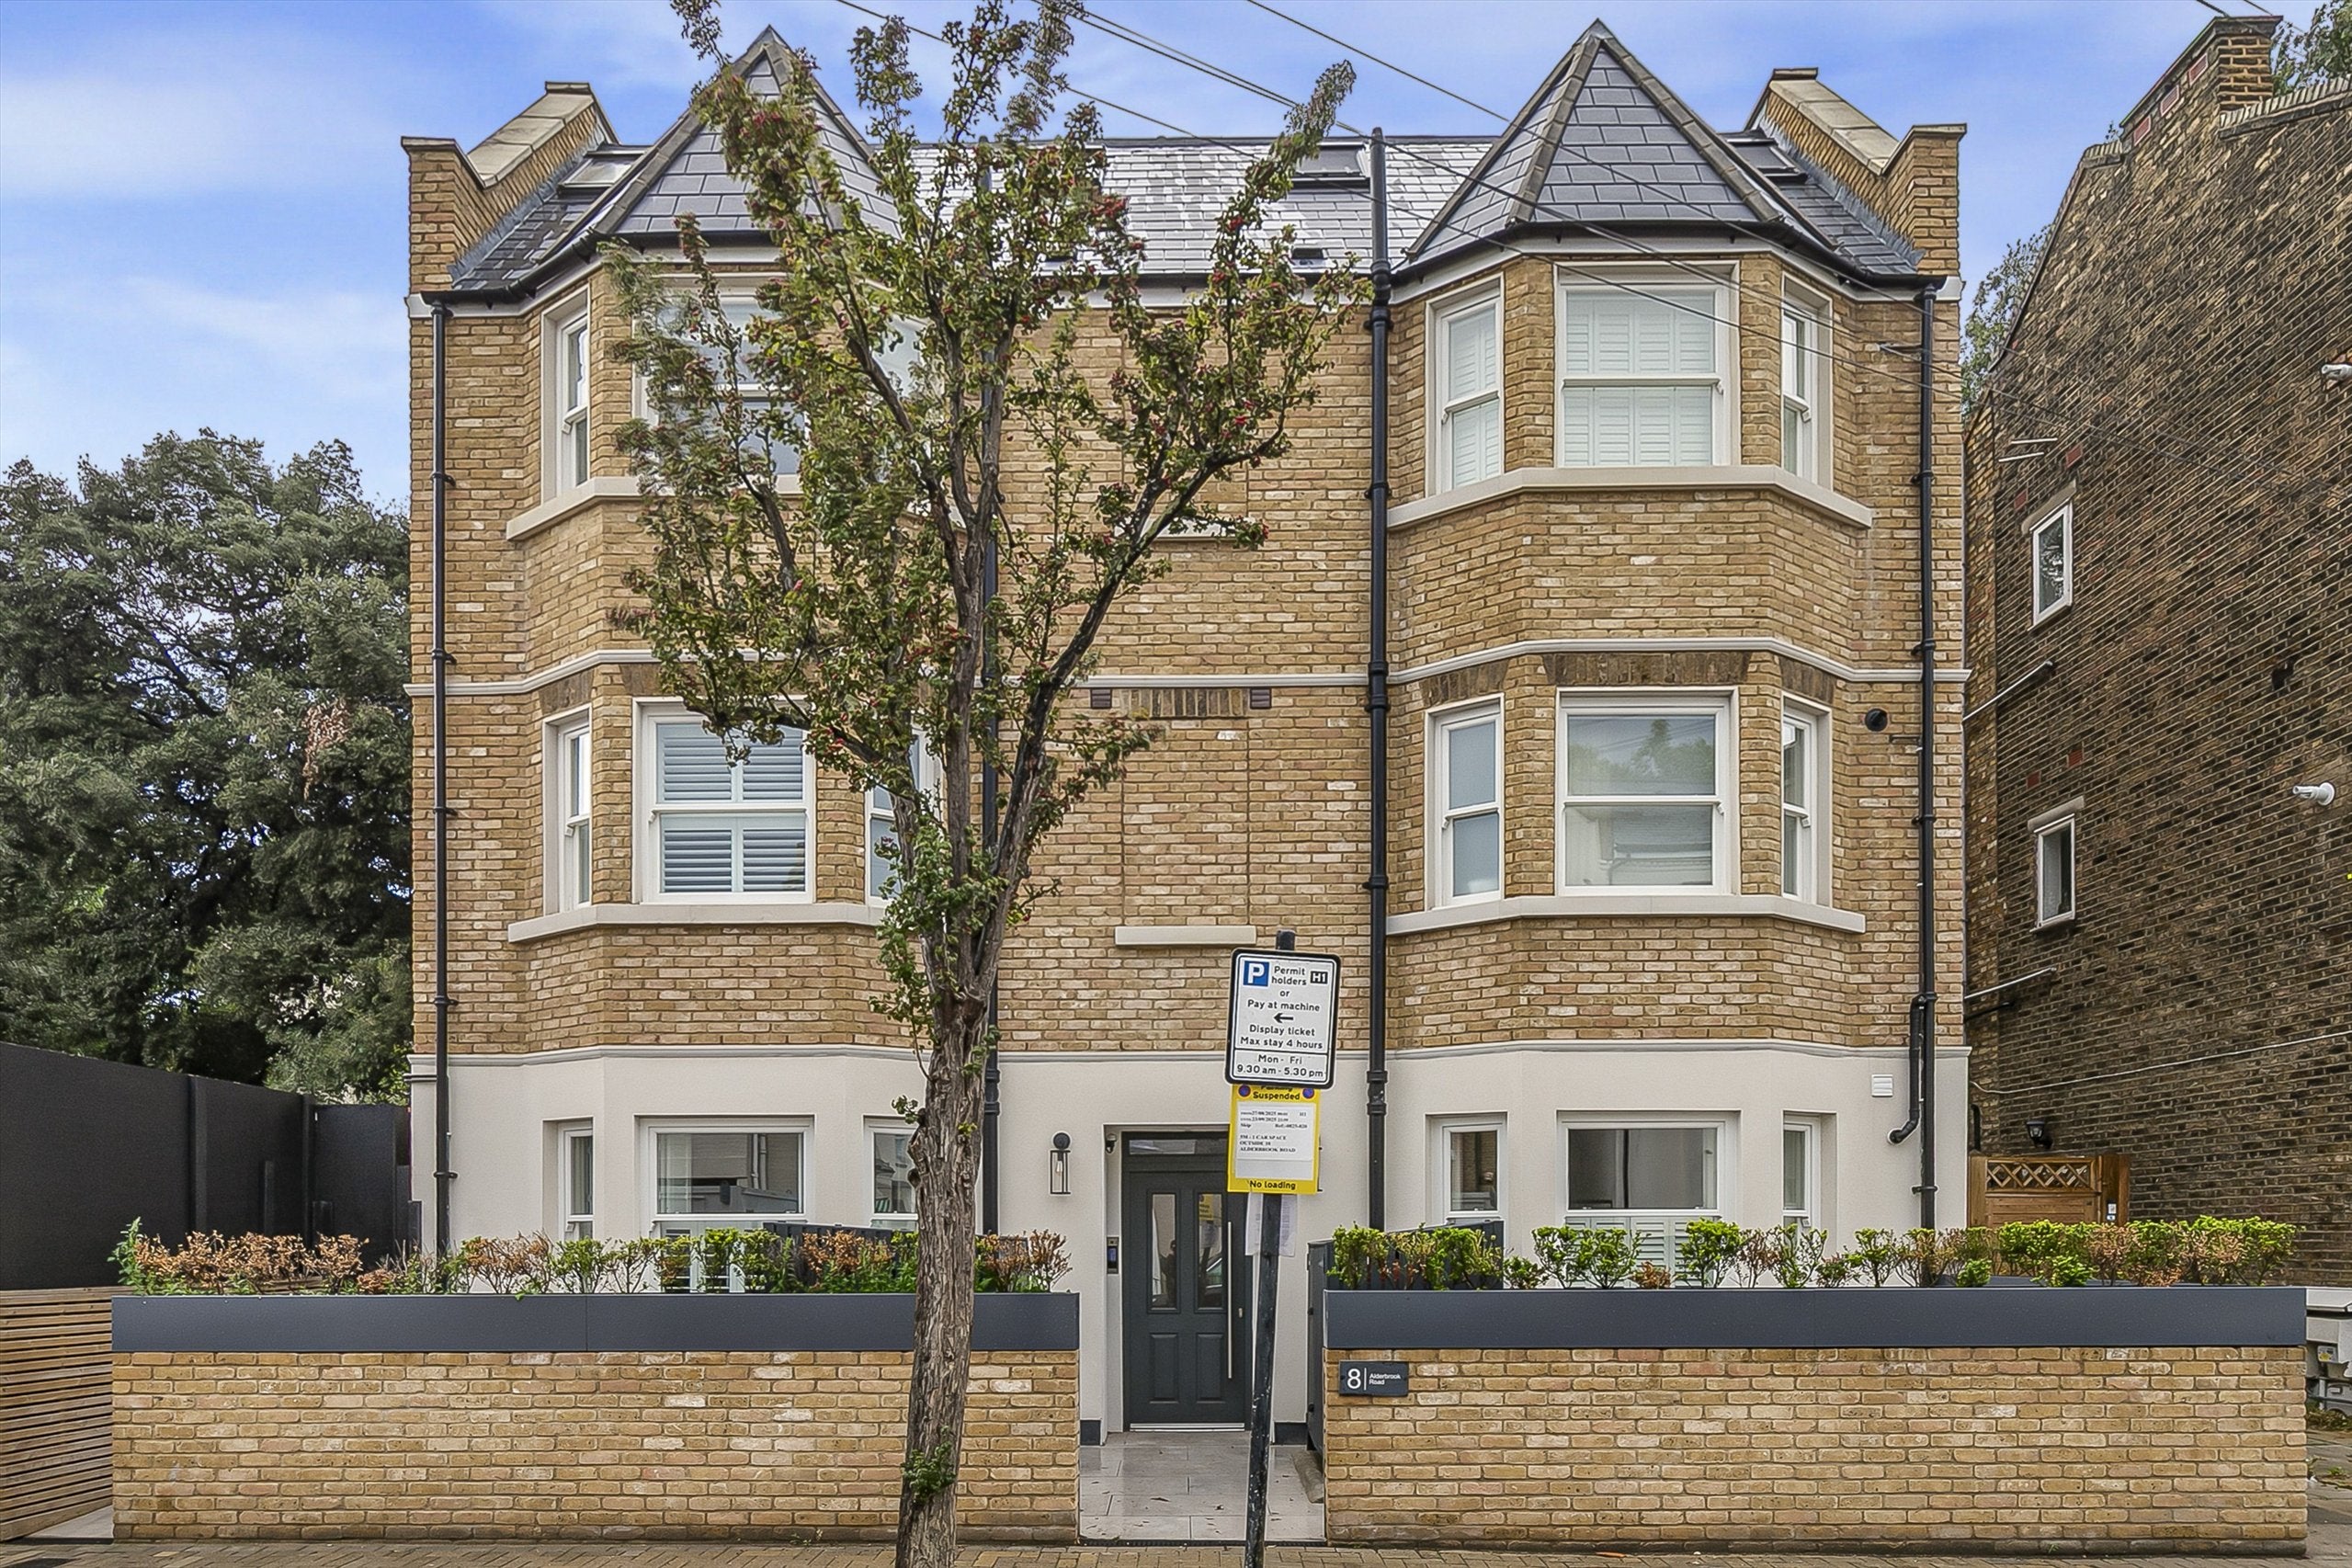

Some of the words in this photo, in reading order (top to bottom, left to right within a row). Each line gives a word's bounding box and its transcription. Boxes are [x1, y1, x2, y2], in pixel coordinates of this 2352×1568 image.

[1248, 963, 1265, 983] P
[1274, 965, 1305, 975] Permit
[1271, 976, 1307, 985] holders
[1312, 972, 1326, 983] H1
[1247, 1000, 1265, 1010] Pay
[1267, 1001, 1278, 1009] at
[1280, 1002, 1320, 1012] machine
[1250, 1025, 1285, 1036] Display
[1288, 1027, 1315, 1036] ticket
[1240, 1037, 1260, 1045] Max
[1263, 1039, 1283, 1048] stay
[1296, 1040, 1323, 1049] hours
[1258, 1054, 1278, 1063] Mon
[1290, 1056, 1302, 1064] Fri
[1237, 1064, 1260, 1074] 9.30
[1284, 1067, 1307, 1076] 5.30
[1309, 1070, 1324, 1078] pm
[1253, 1091, 1301, 1100] Suspended
[1264, 1181, 1296, 1190] loading
[1346, 1369, 1361, 1389] 8
